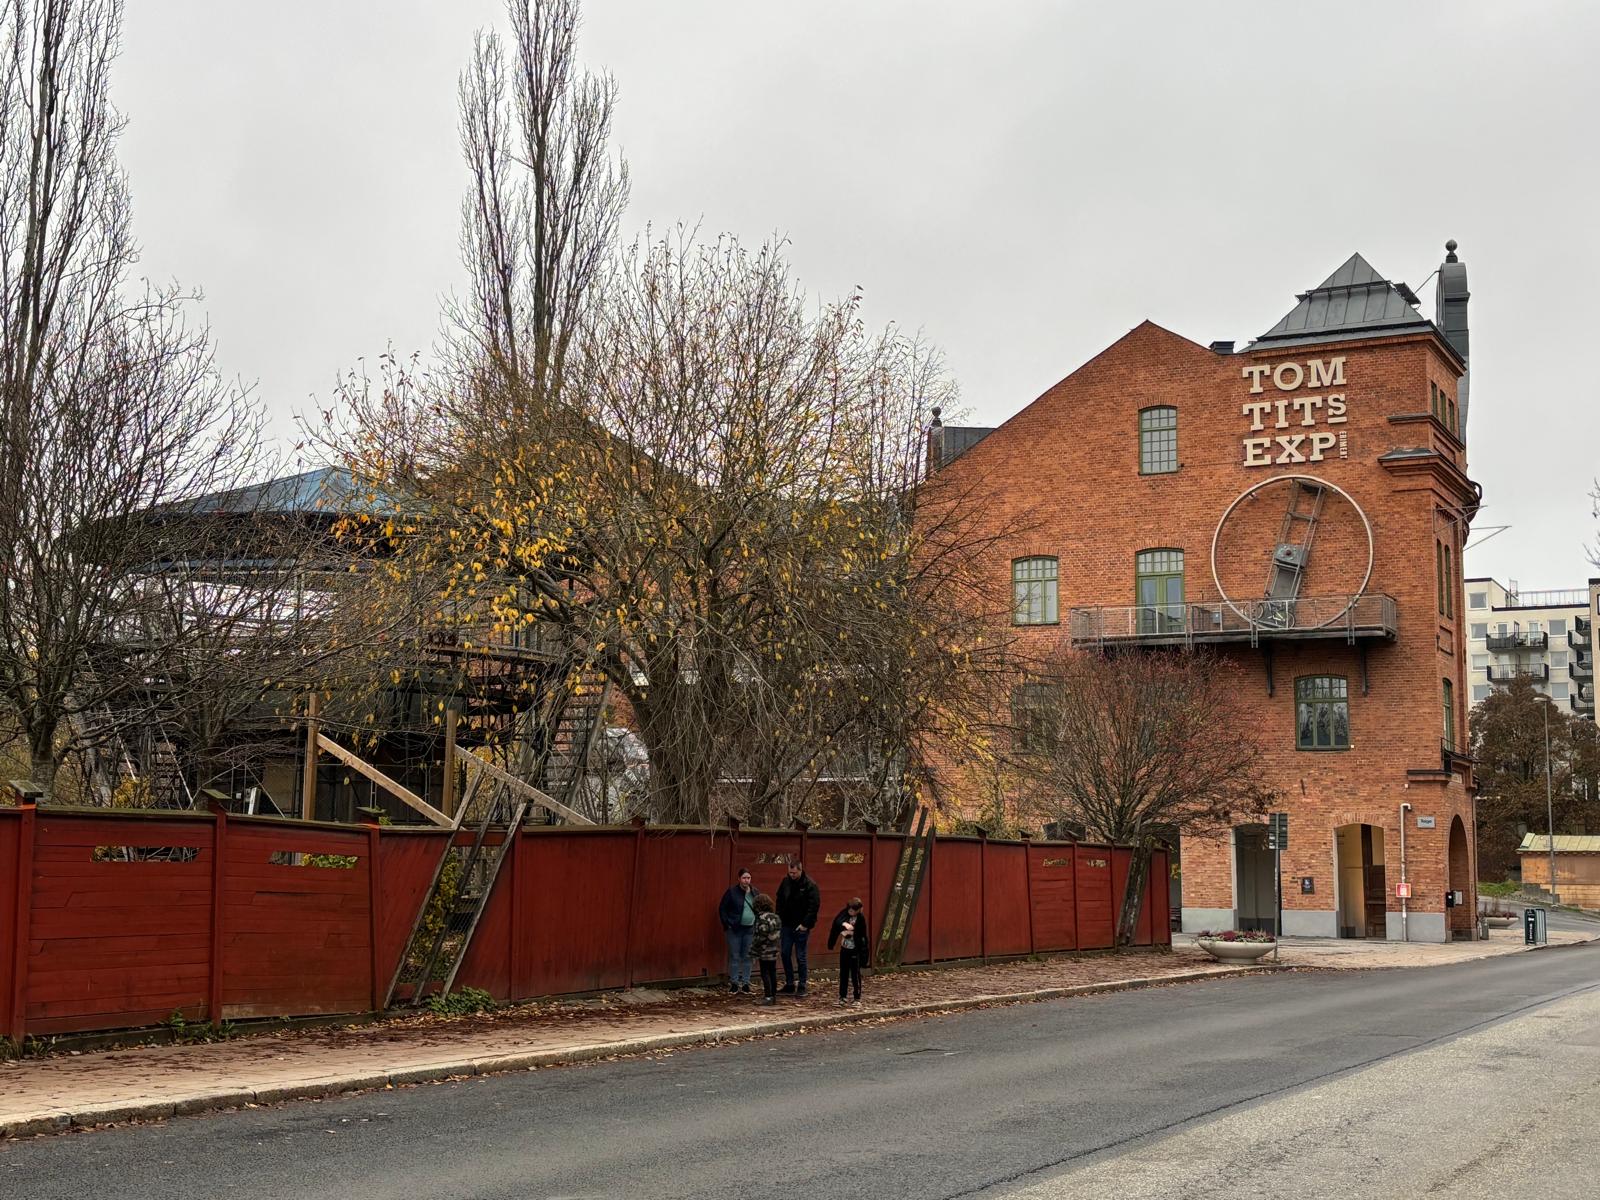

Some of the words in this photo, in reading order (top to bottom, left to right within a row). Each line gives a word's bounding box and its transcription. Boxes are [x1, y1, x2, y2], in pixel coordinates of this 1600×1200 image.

[1242, 356, 1347, 393] TOM
[1242, 393, 1347, 431] TITS
[1243, 432, 1336, 467] EXP
